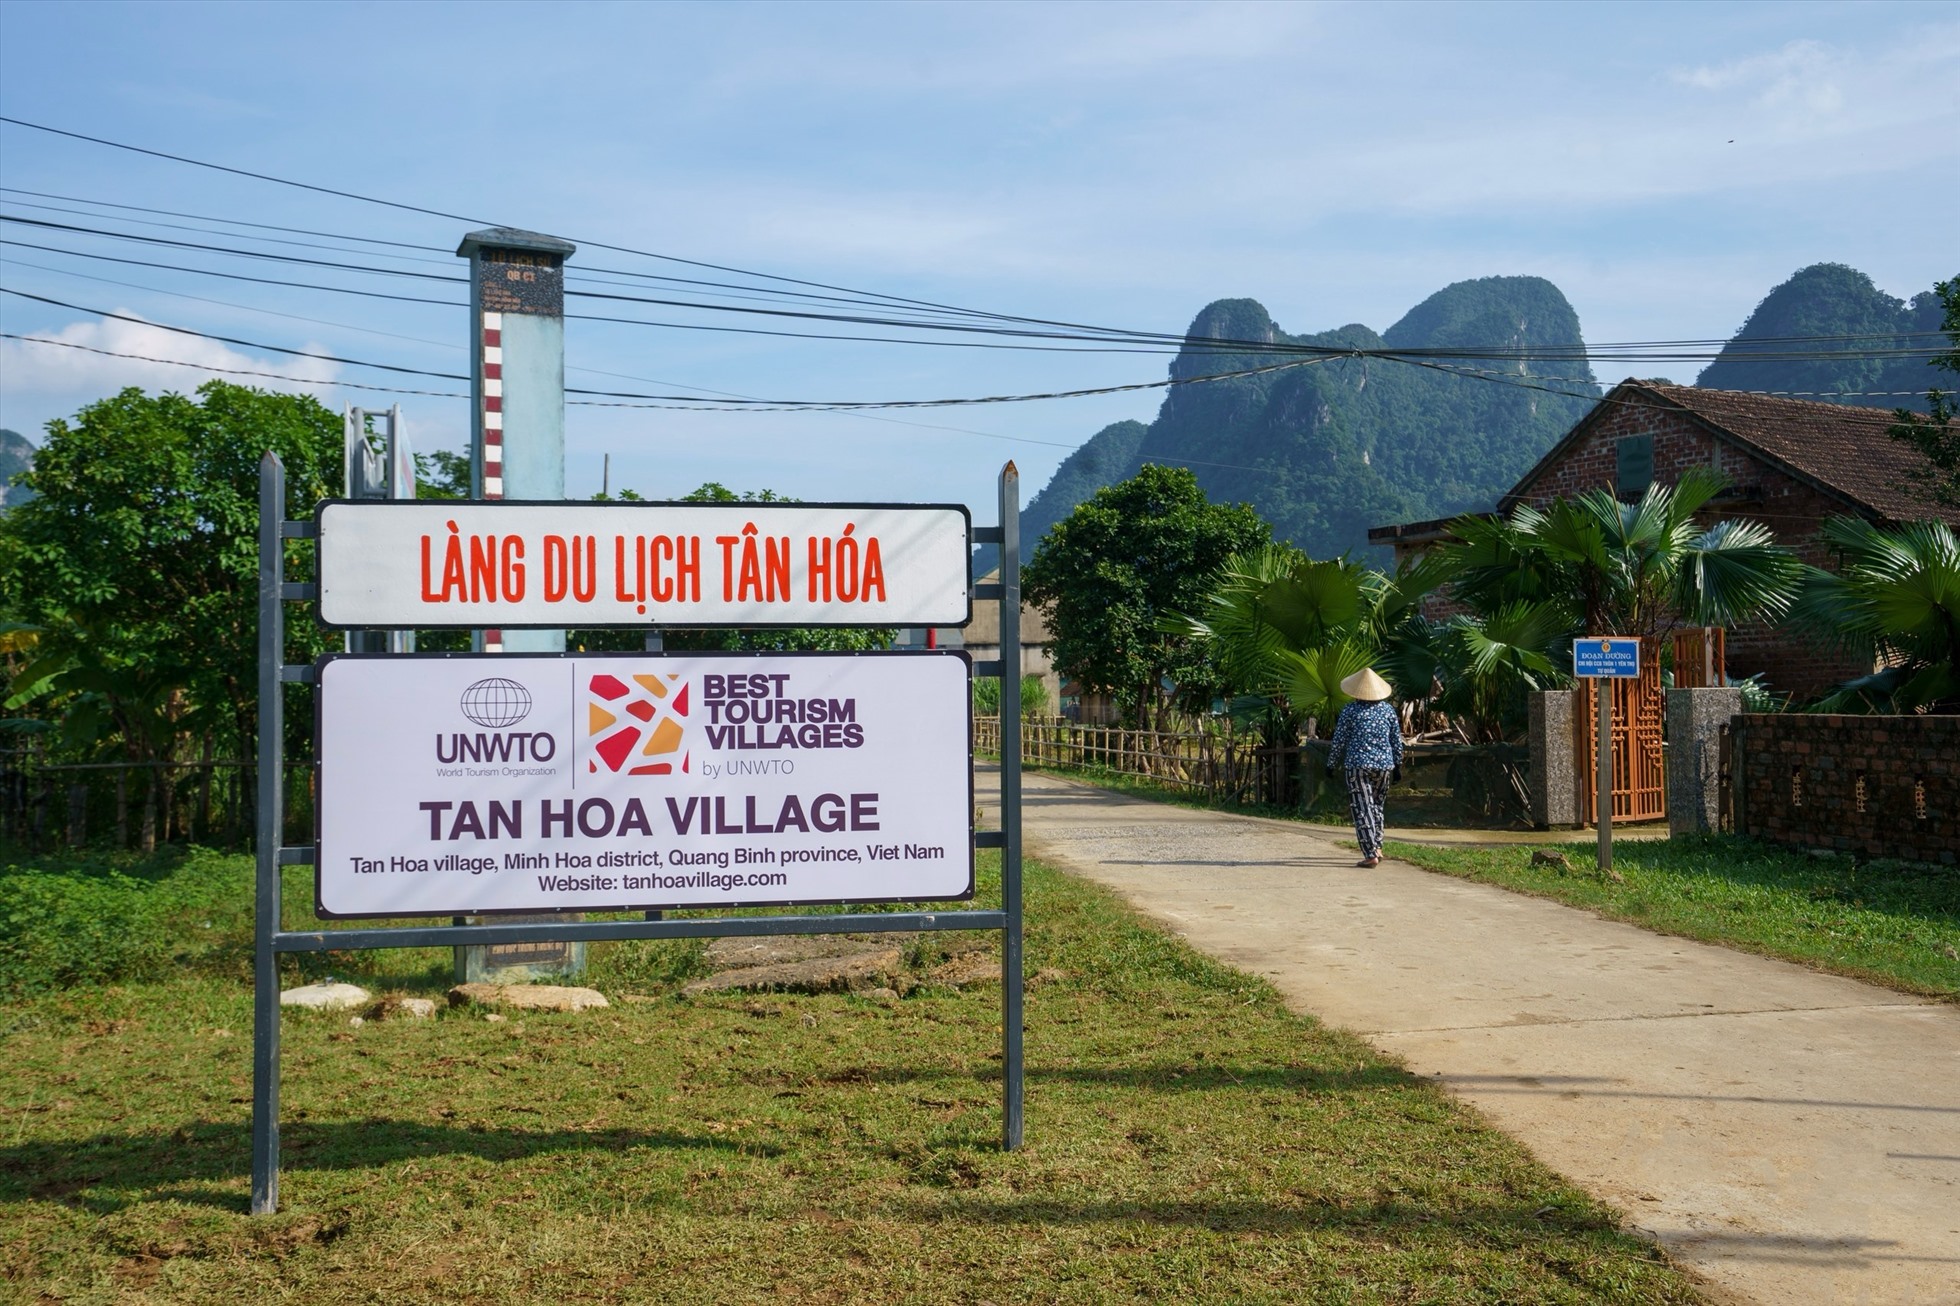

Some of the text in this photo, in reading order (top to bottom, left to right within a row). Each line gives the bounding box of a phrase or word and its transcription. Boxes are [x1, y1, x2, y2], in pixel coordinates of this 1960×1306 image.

[422, 521, 885, 613] LÀNG DU LỊCH TÂN HÓA
[704, 674, 790, 699] BEST
[704, 699, 855, 724] TOURISM
[437, 732, 555, 763] UNWTO
[705, 724, 864, 750] VILLAGES
[437, 767, 556, 777] World Tourism Organization
[702, 760, 794, 779] by UNWTO
[419, 793, 880, 840] TAN HOA VILLAGE
[350, 844, 944, 875] Tan Hoa village, Minh Hoa district, Quang Binh province, Viet Nam
[538, 872, 786, 891] Website: tanhoavillage.com
